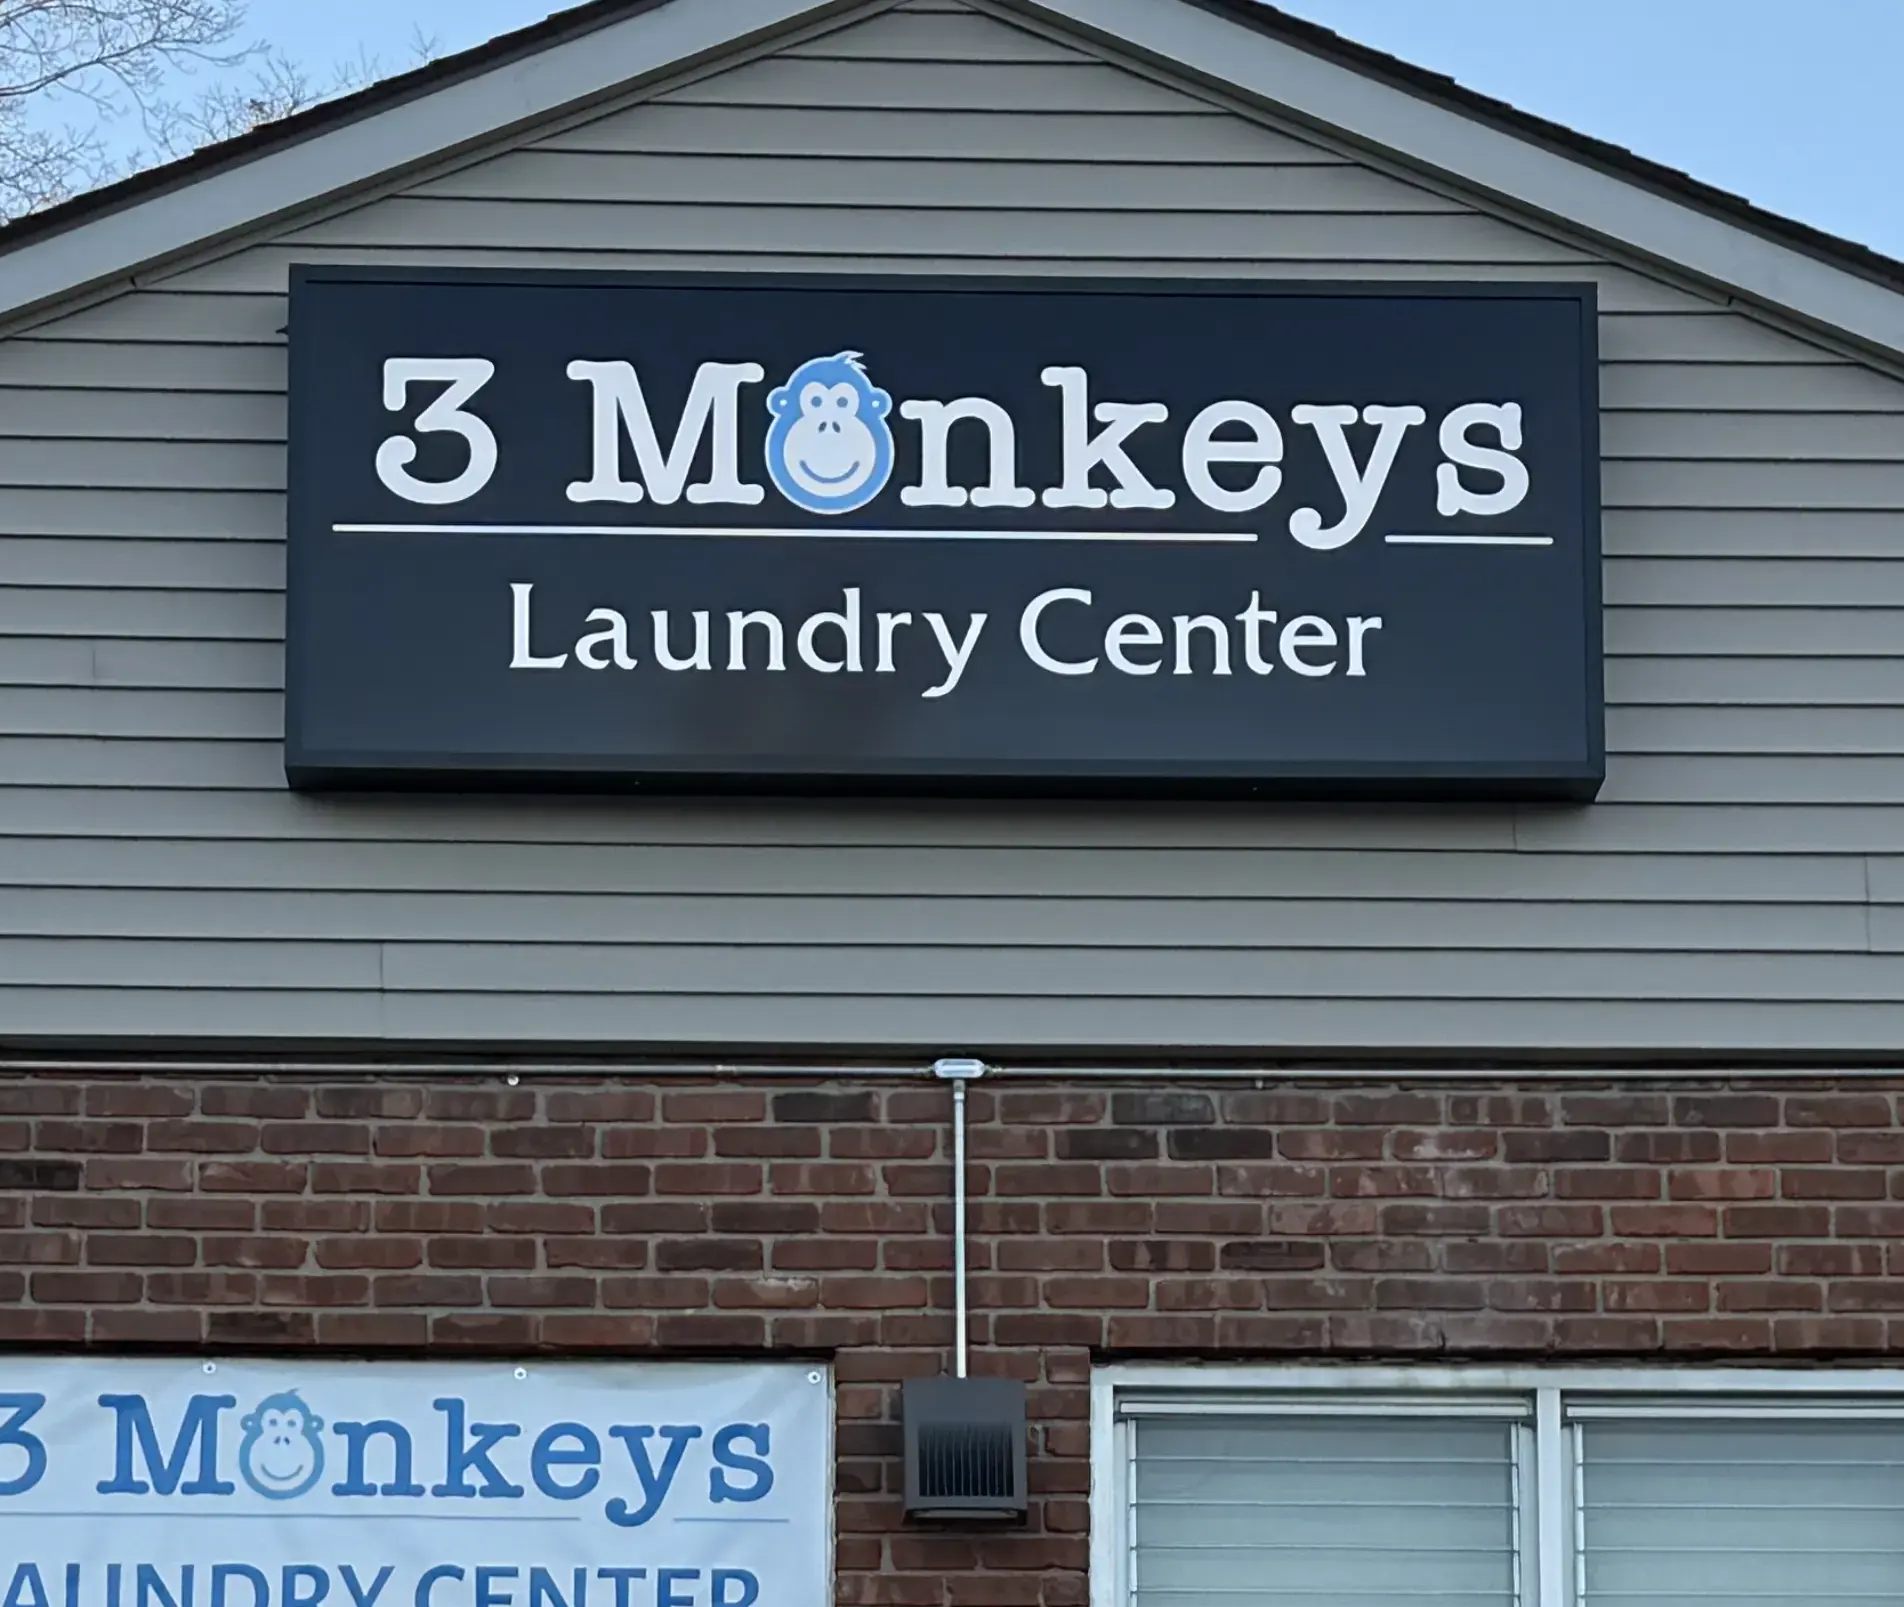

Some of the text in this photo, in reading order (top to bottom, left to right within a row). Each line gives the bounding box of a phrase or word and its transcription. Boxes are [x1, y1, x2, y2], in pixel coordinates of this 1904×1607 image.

[375, 357, 498, 505] 3
[509, 583, 1384, 698] Laundry Center
